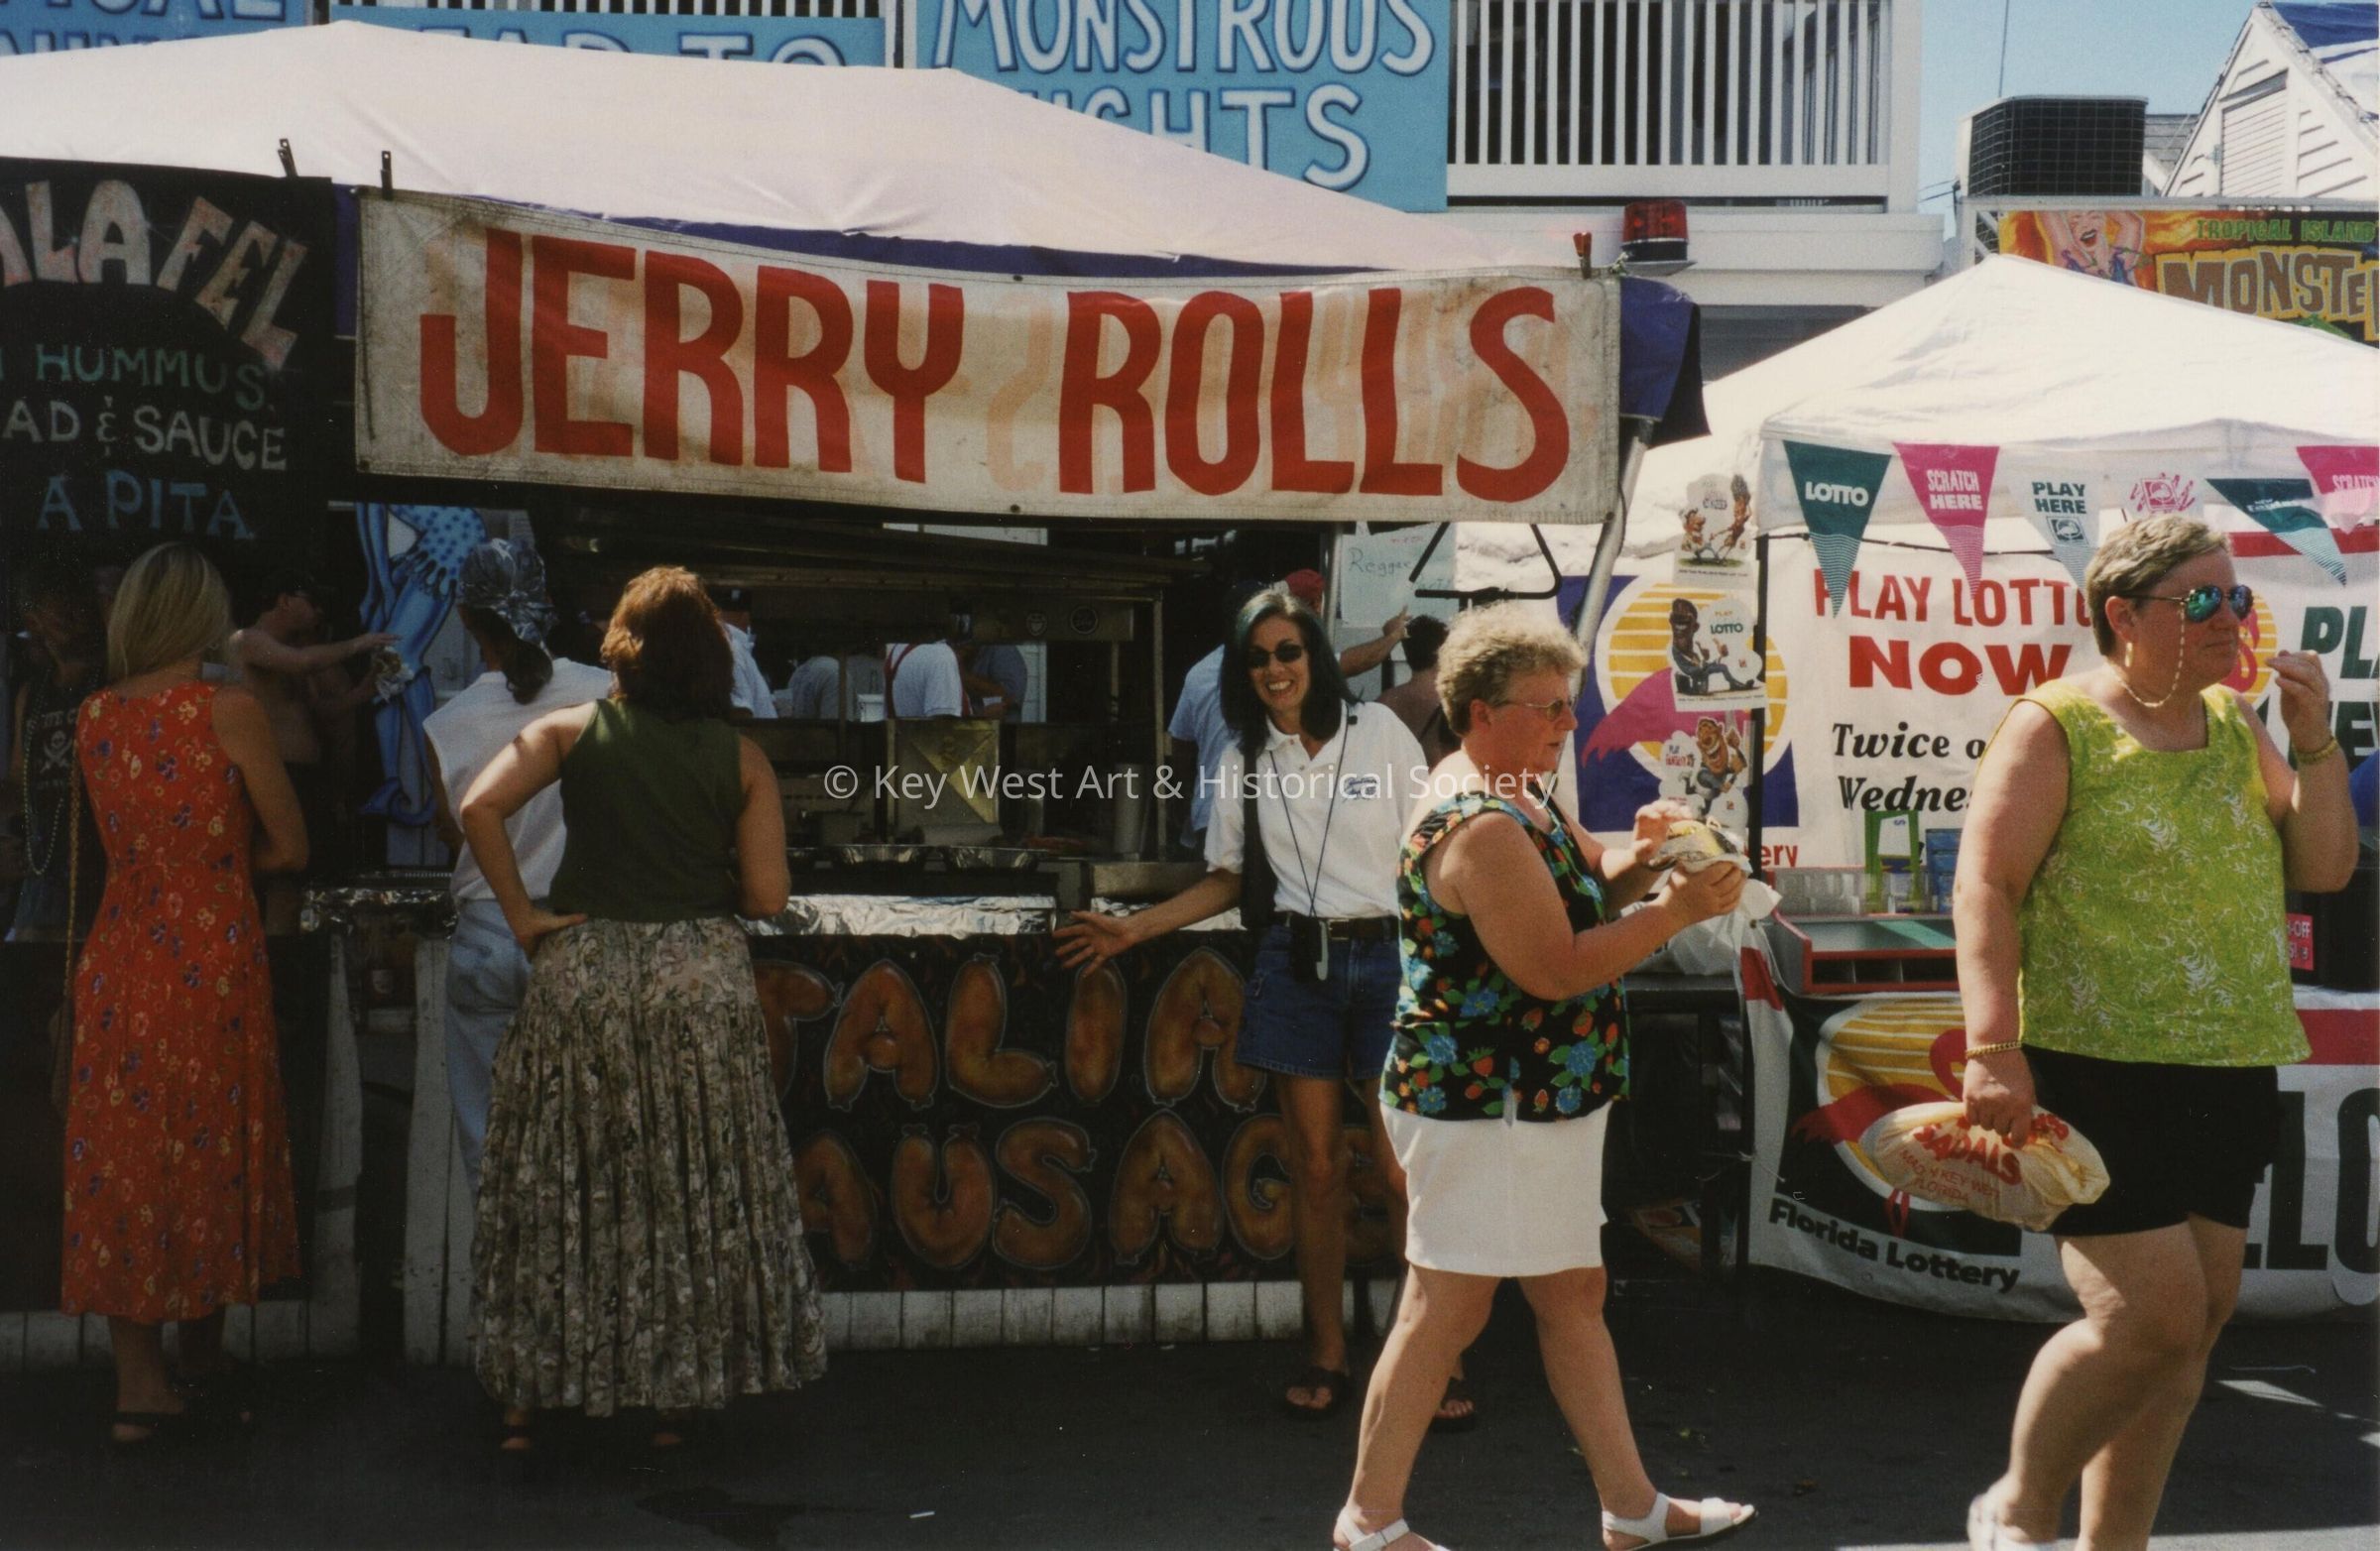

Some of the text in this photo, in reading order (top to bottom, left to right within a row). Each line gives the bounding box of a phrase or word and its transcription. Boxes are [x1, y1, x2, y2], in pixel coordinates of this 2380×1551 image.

[933, 0, 1435, 76] MONSTROUS
[2196, 219, 2292, 242] TROPICAL
[2163, 250, 2379, 334] MONSTE
[420, 228, 1570, 503] JERRY ROLLS
[133, 405, 287, 471] SAUCE
[1805, 481, 1868, 507] LOTTO
[1926, 469, 1979, 493] SCRATCH
[2032, 481, 2085, 498] PLAY
[38, 475, 82, 532] A
[1930, 494, 1983, 511] HERE
[2034, 498, 2087, 515] HERE
[1711, 623, 1743, 634] LOTTO
[2301, 606, 2380, 679] PL
[1849, 635, 2073, 696] NOW
[1833, 722, 1951, 759] Twice
[1838, 776, 1972, 812] Wedne
[1941, 1169, 1967, 1186] KEY
[1768, 1196, 2022, 1290] Florida Lottery
